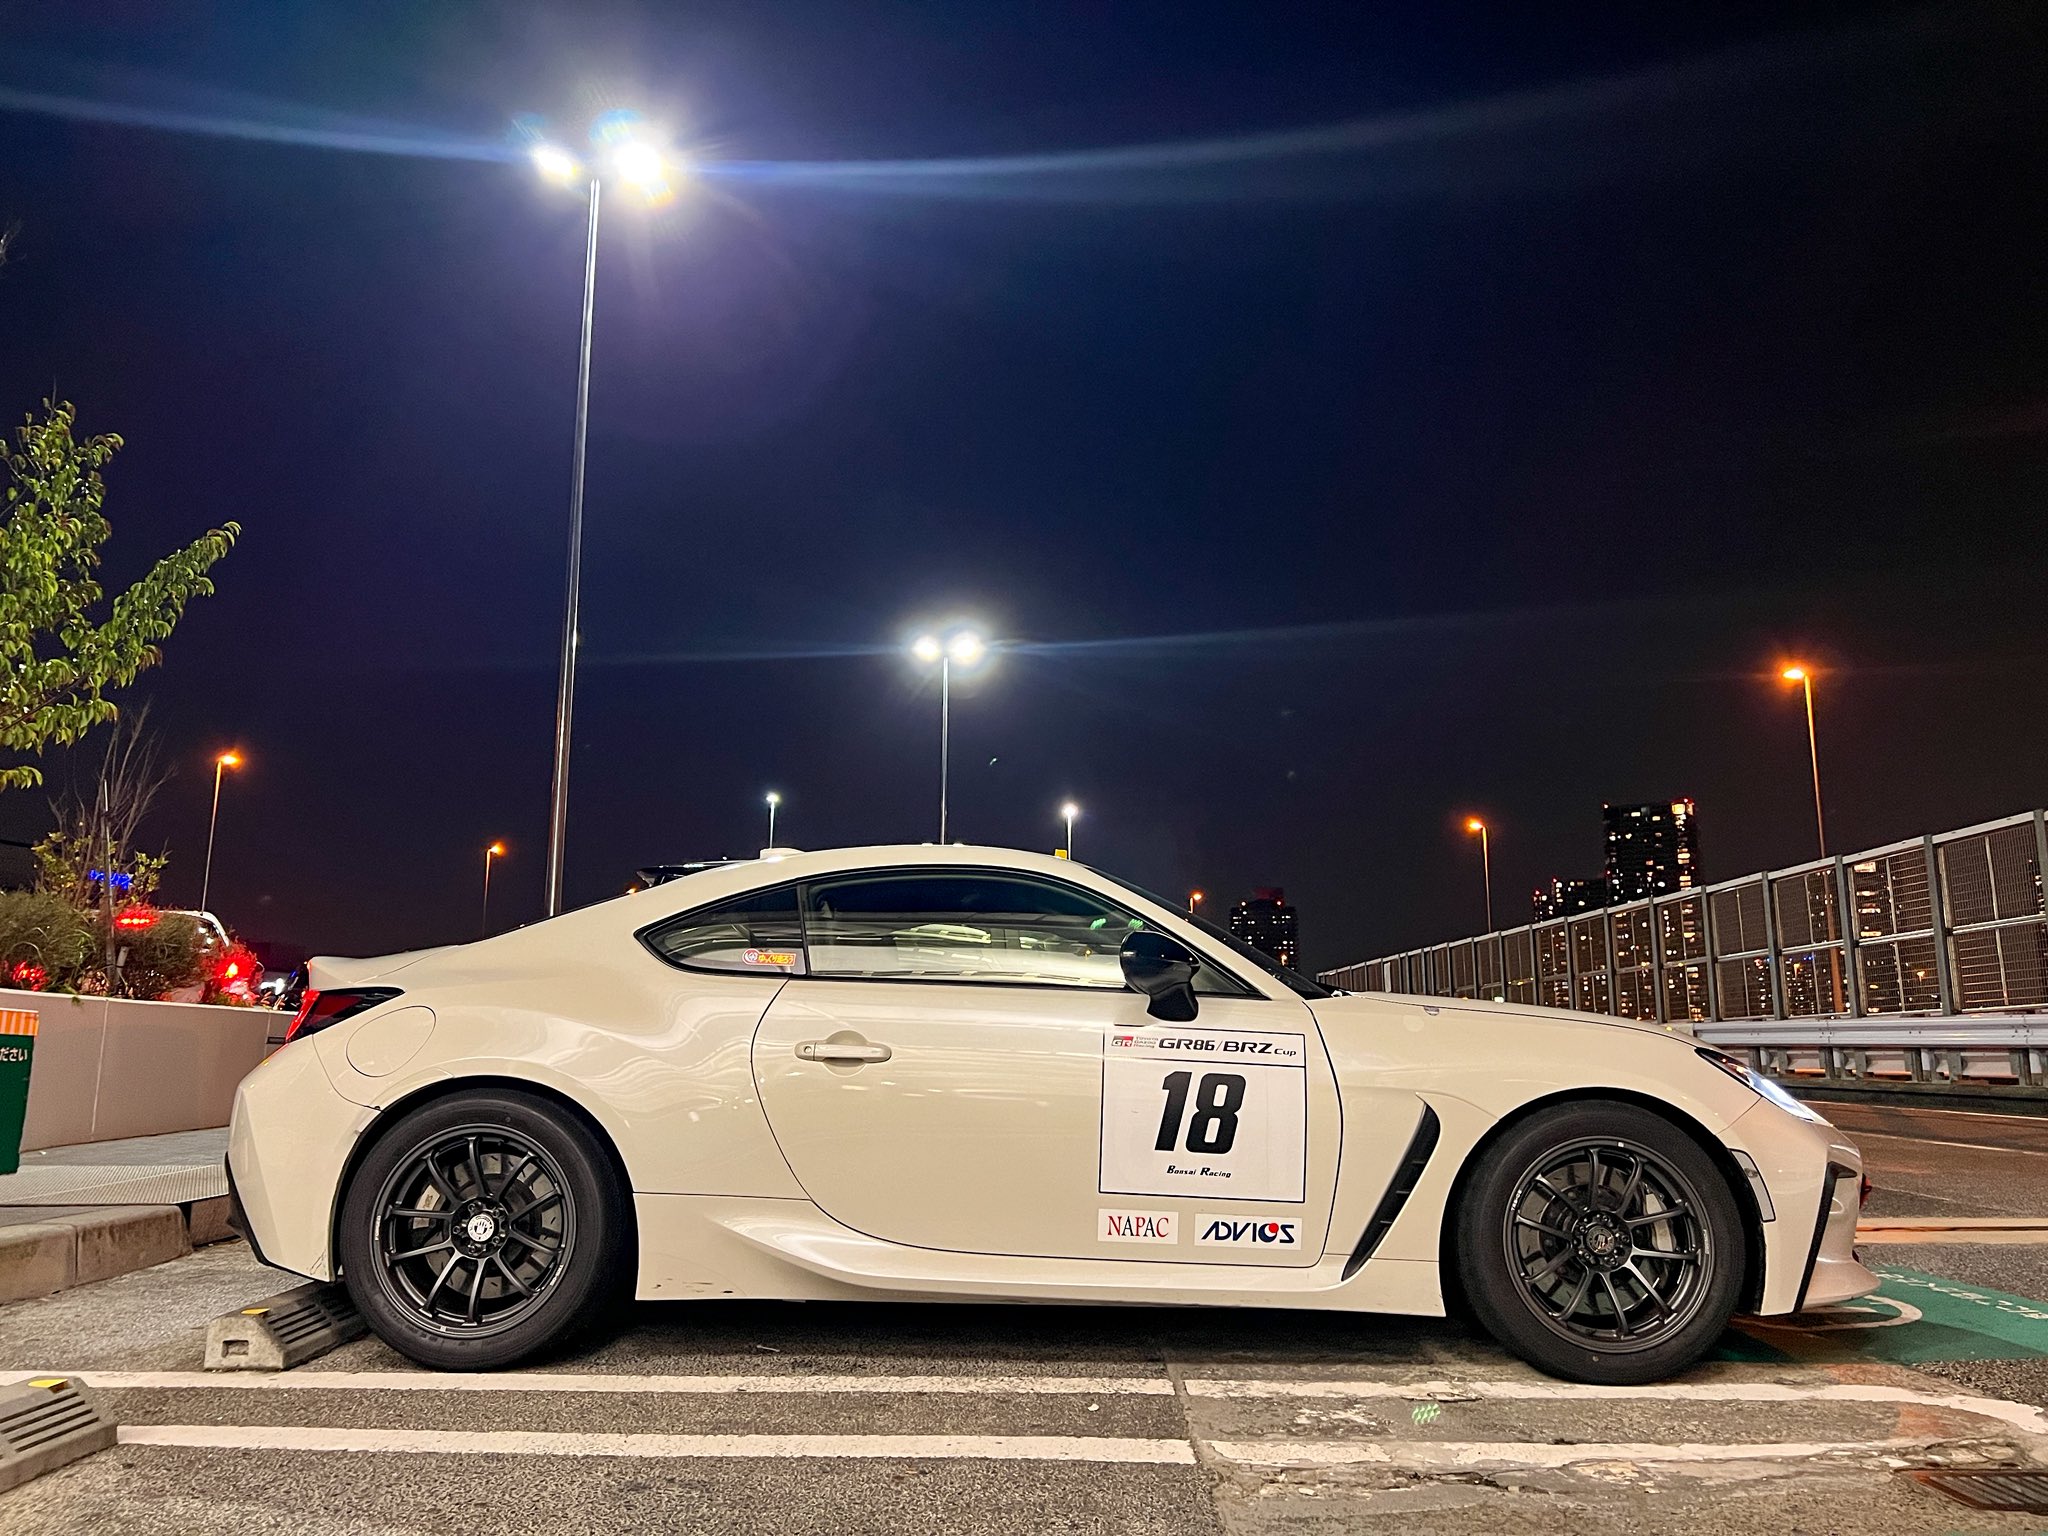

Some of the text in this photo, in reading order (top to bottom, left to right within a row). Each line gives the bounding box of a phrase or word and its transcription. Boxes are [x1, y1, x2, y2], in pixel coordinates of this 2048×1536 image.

[1111, 1039, 1133, 1048] GR
[1274, 1048, 1297, 1057] Cup
[1154, 1070, 1247, 1154] 18
[1166, 1164, 1232, 1178] Bonsai Racing
[1107, 1215, 1169, 1238] NAPAC
[1201, 1220, 1295, 1244] ADVICS
